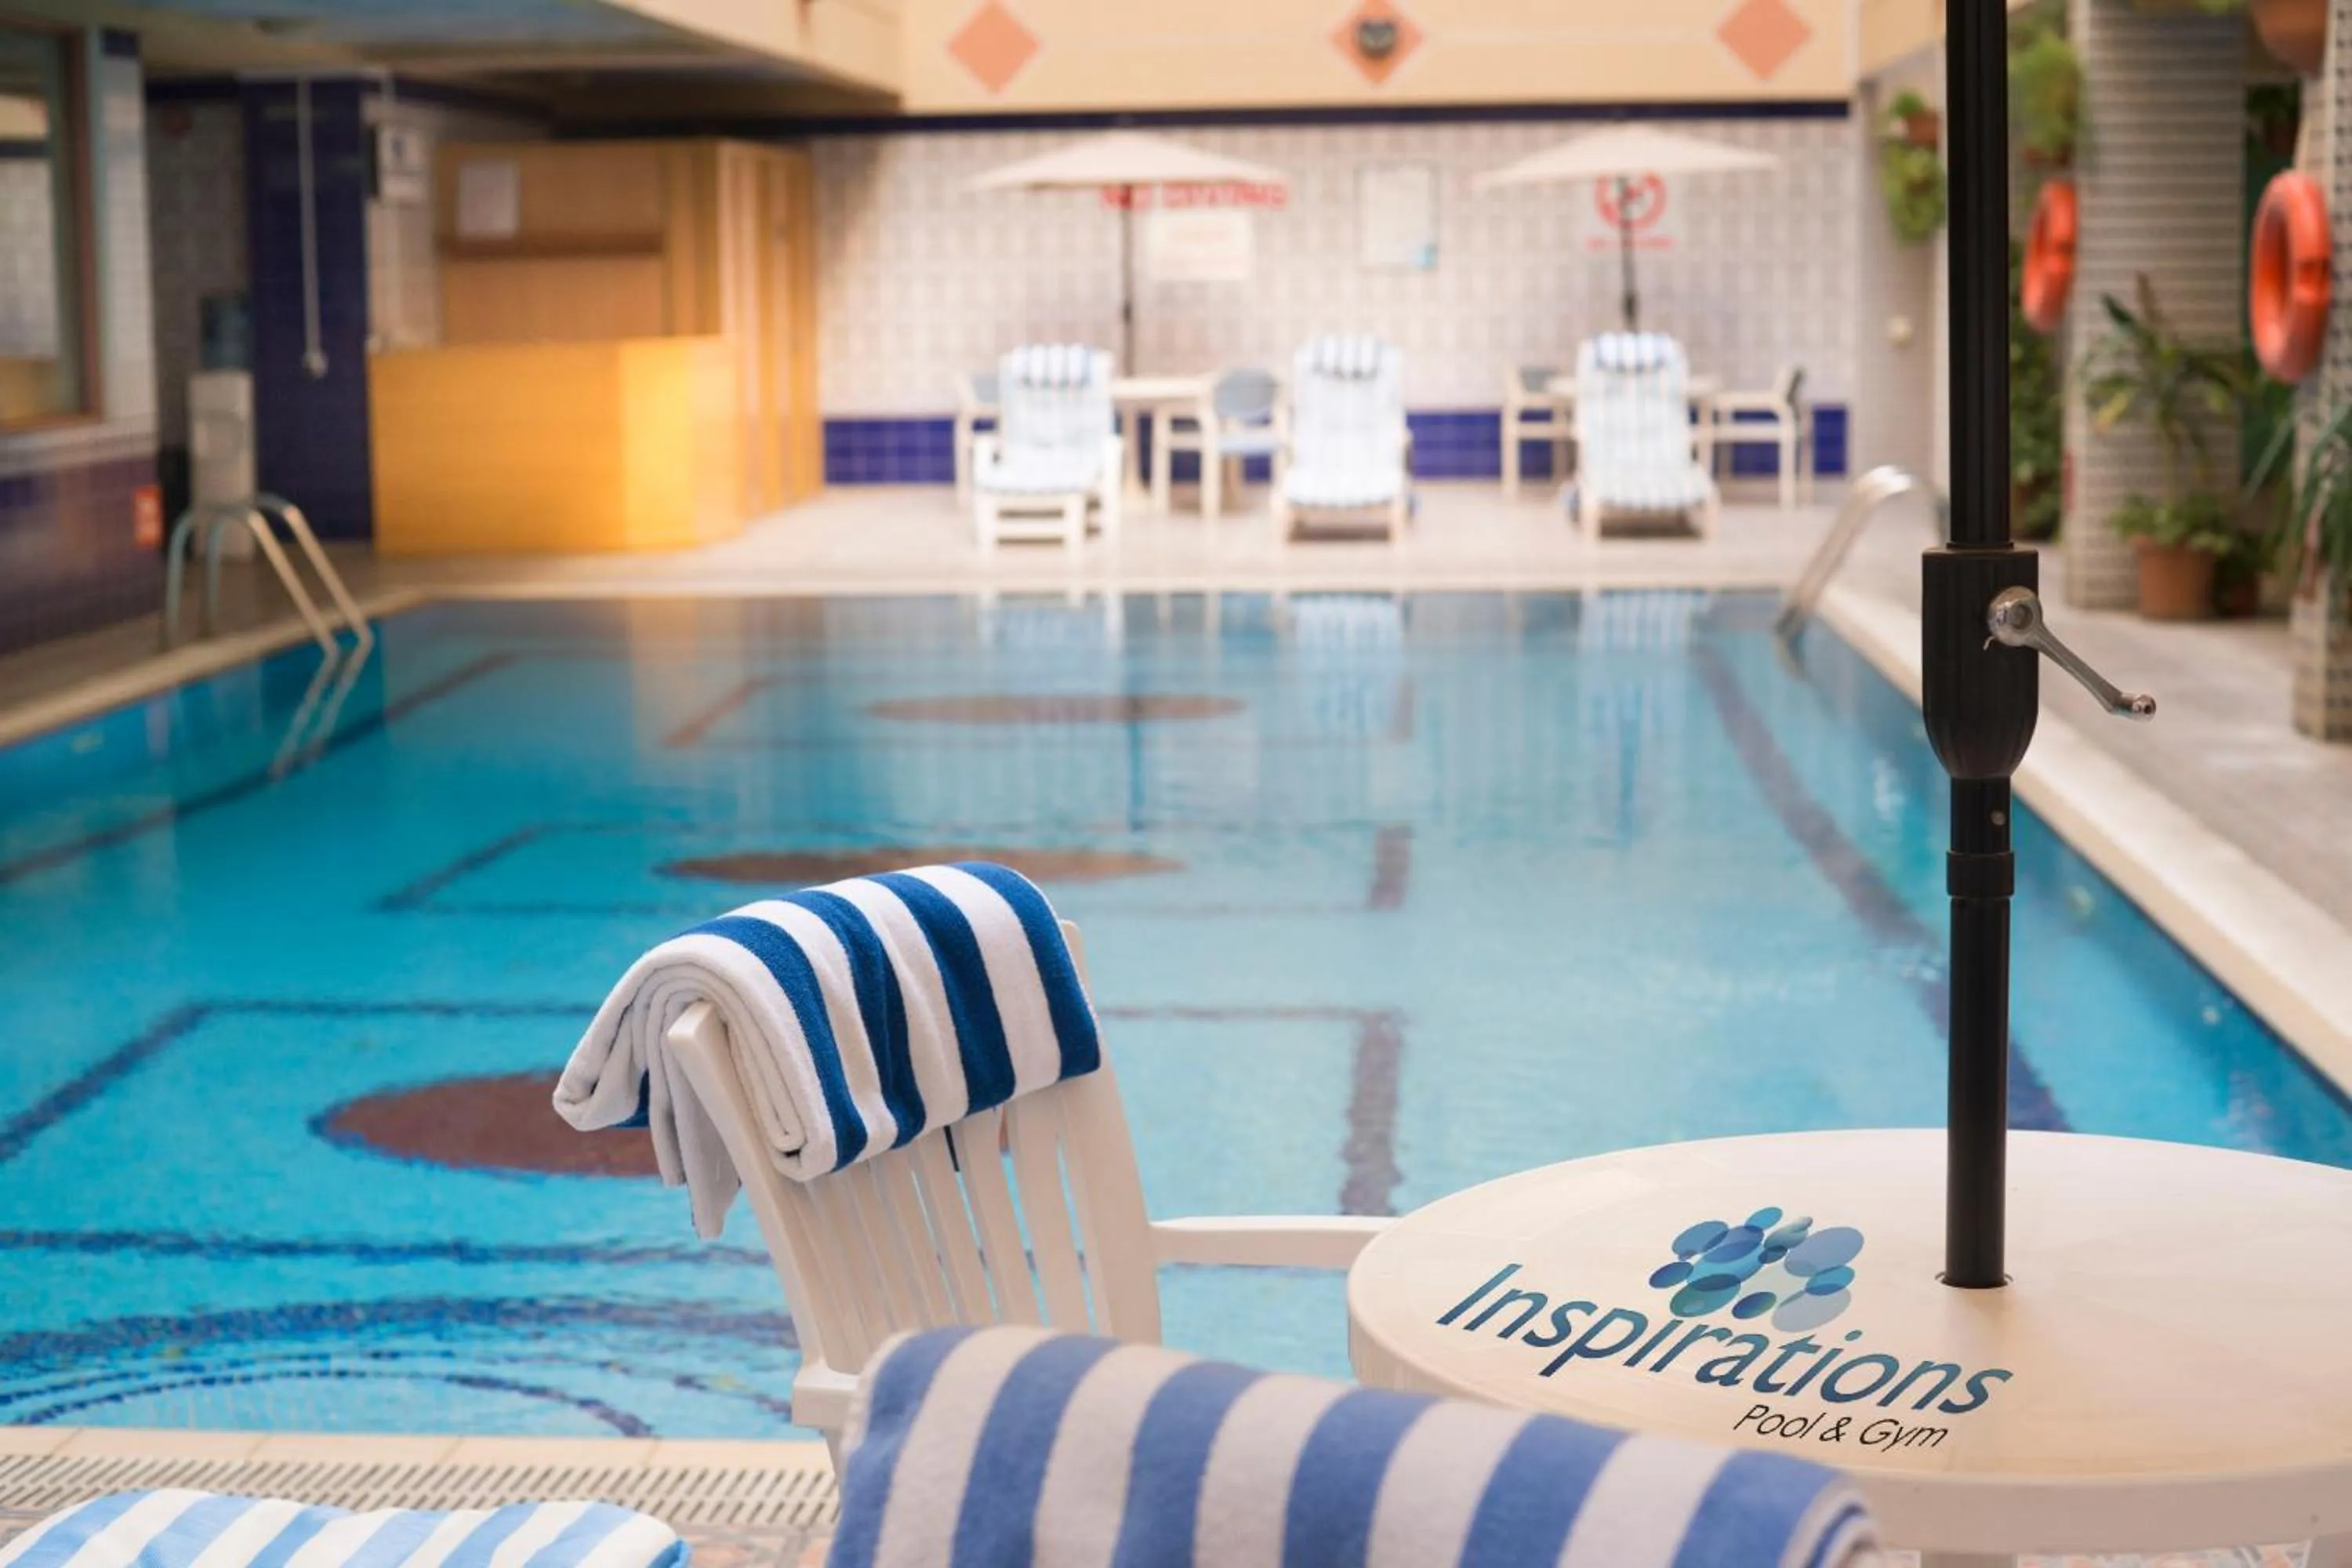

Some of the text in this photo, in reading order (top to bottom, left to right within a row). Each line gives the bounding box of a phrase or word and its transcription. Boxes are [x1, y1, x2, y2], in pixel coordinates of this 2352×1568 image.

[1436, 1263, 2013, 1414] Inspirations
[1733, 1404, 1949, 1452] Pool & Gym
